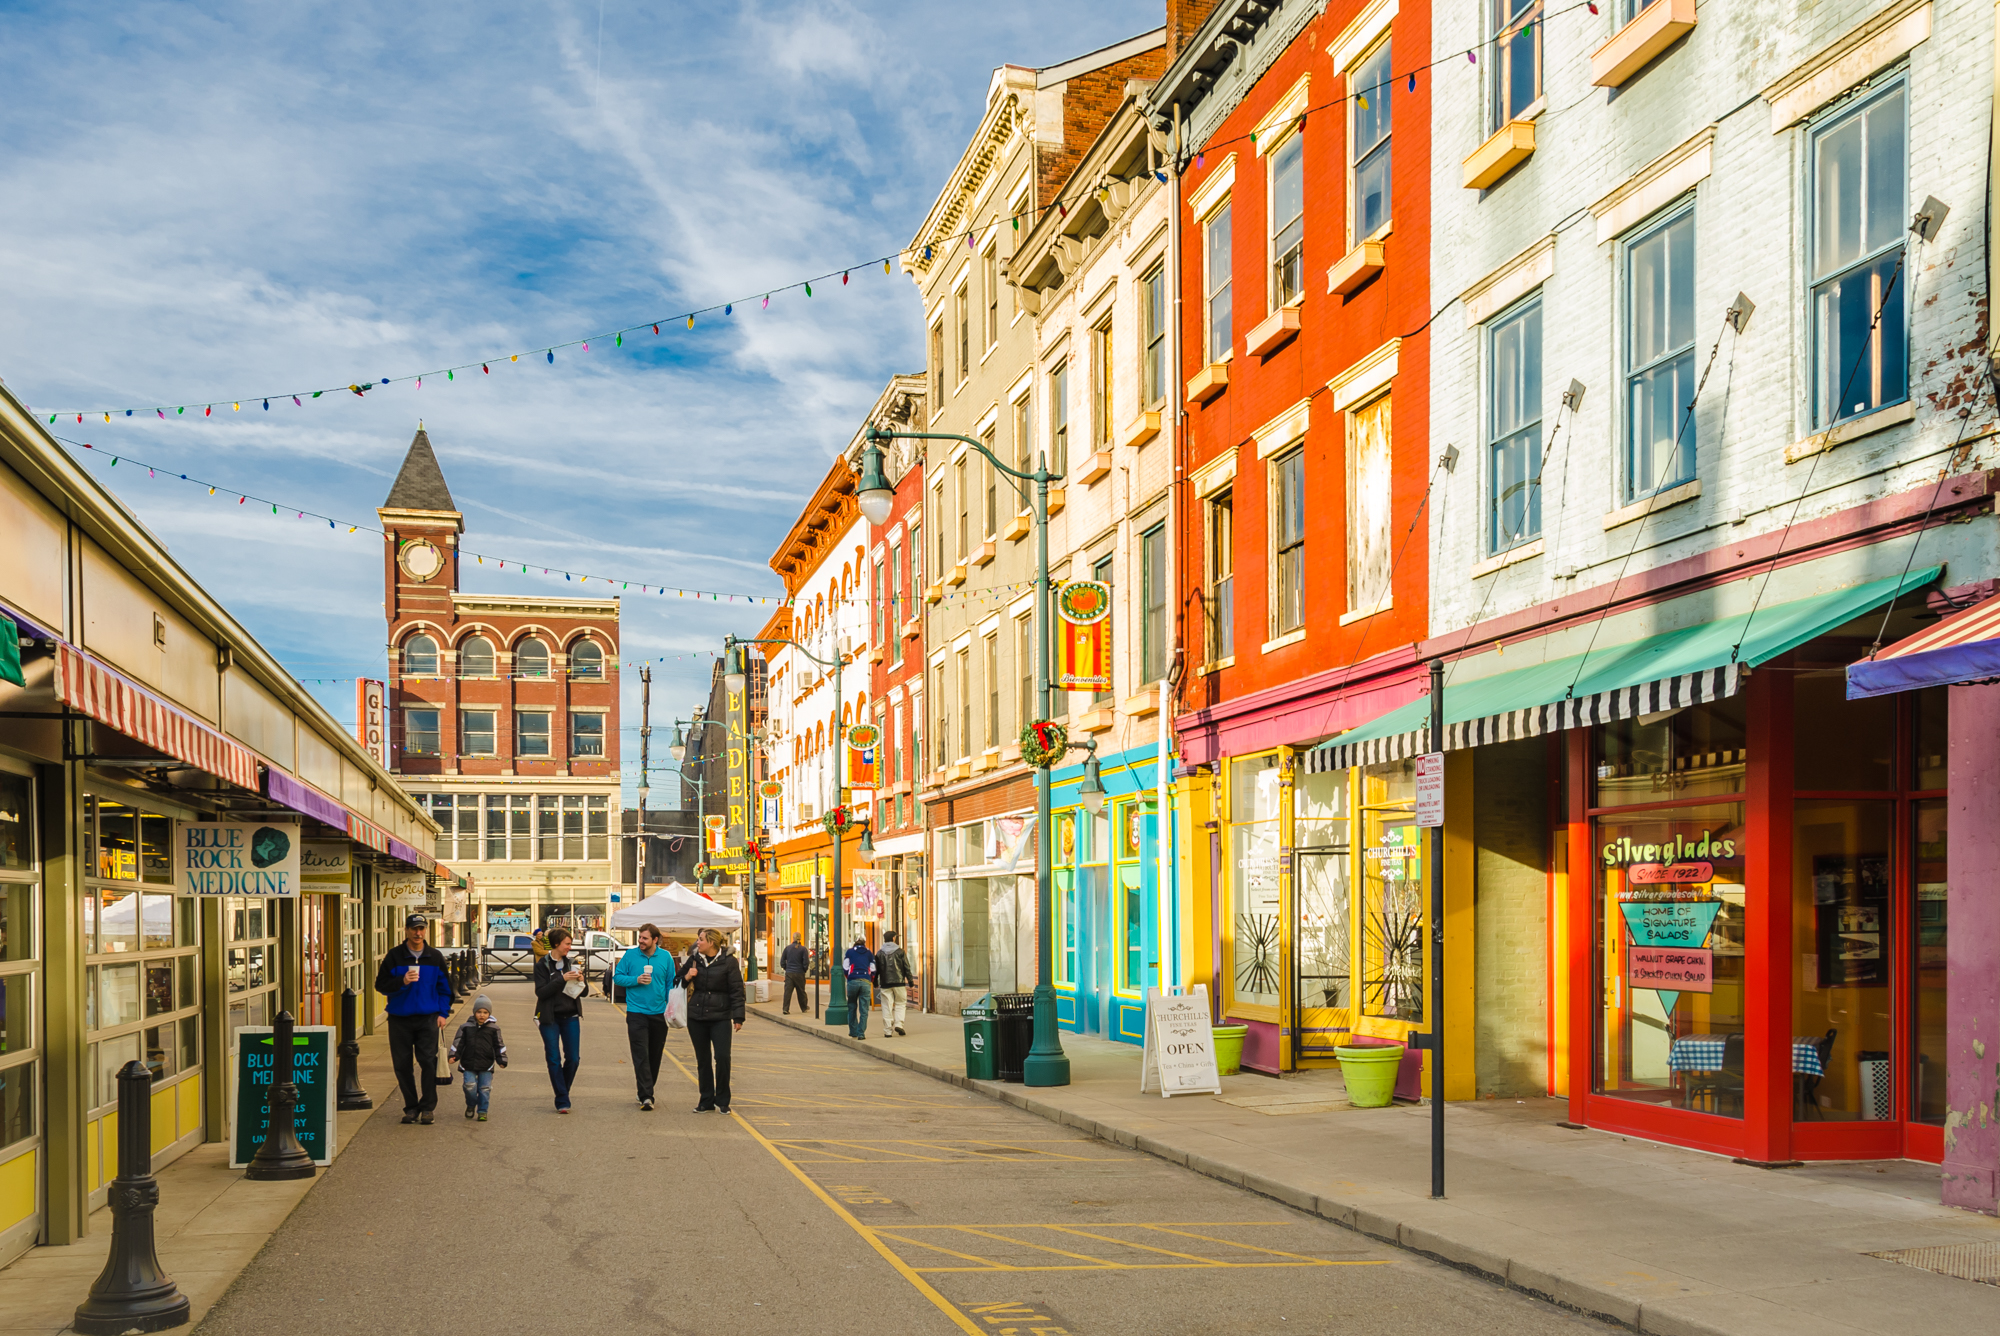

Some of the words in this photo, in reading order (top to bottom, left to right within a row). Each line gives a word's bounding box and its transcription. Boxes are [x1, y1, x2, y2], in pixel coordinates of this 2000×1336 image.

[1064, 583, 1103, 597] FINDLAY
[1068, 604, 1104, 619] MARKET
[1060, 673, 1108, 684] Bienvenidos
[368, 694, 380, 762] GLOB
[728, 691, 744, 826] EADER
[1417, 758, 1425, 774] NO
[1650, 771, 1684, 793] 120
[185, 828, 244, 848] BLUE
[1367, 845, 1417, 859] CHURCHILL'S
[1602, 830, 1735, 868] Silverglades
[185, 849, 243, 869] ROCK
[300, 849, 346, 867] etina
[1636, 868, 1668, 880] SINCE
[186, 871, 290, 895] MEDICINE
[381, 880, 425, 899] Honey
[1642, 907, 1674, 916] HOME
[1677, 907, 1691, 916] OF
[1635, 955, 1664, 963] WALNUT
[1665, 955, 1686, 964] GRAPE
[1684, 971, 1706, 982] SALAD
[1155, 1011, 1210, 1022] CHURCHILL'S
[1166, 1042, 1205, 1056] OPEN
[247, 1053, 274, 1068] BLU
[293, 1052, 320, 1067] OCK
[1200, 1060, 1215, 1068] Gifts
